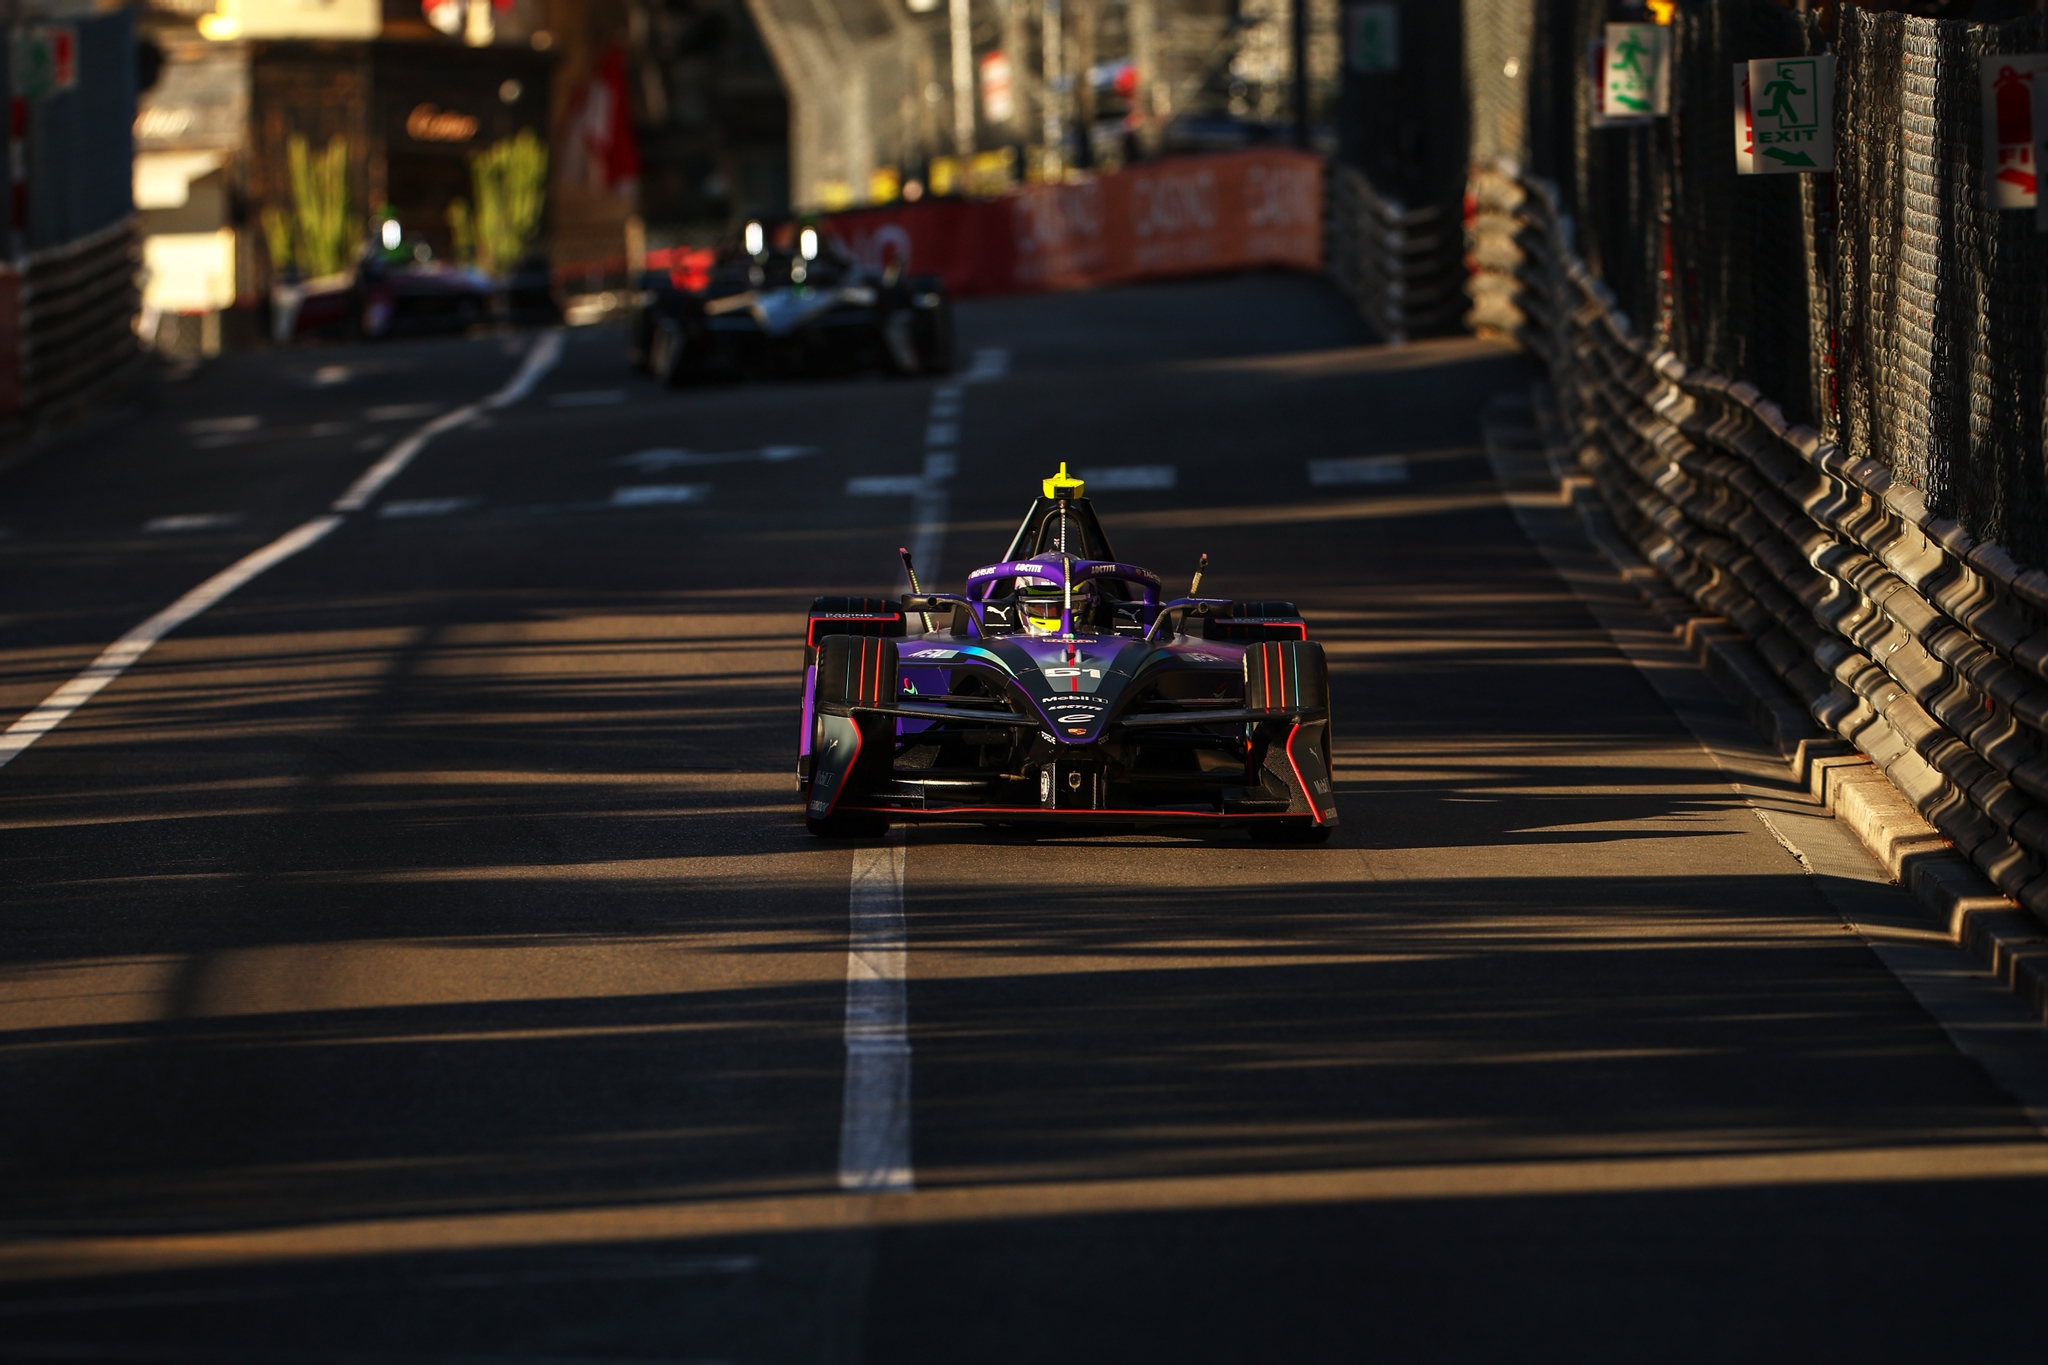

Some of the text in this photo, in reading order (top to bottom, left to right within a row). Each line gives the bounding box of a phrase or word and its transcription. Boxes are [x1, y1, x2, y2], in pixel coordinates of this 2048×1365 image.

[1758, 129, 1818, 144] EXIT
[1014, 563, 1043, 573] LOCTITE
[1091, 564, 1116, 574] LOCTITE
[1044, 667, 1101, 679] 51
[1042, 695, 1090, 703] Mobil
